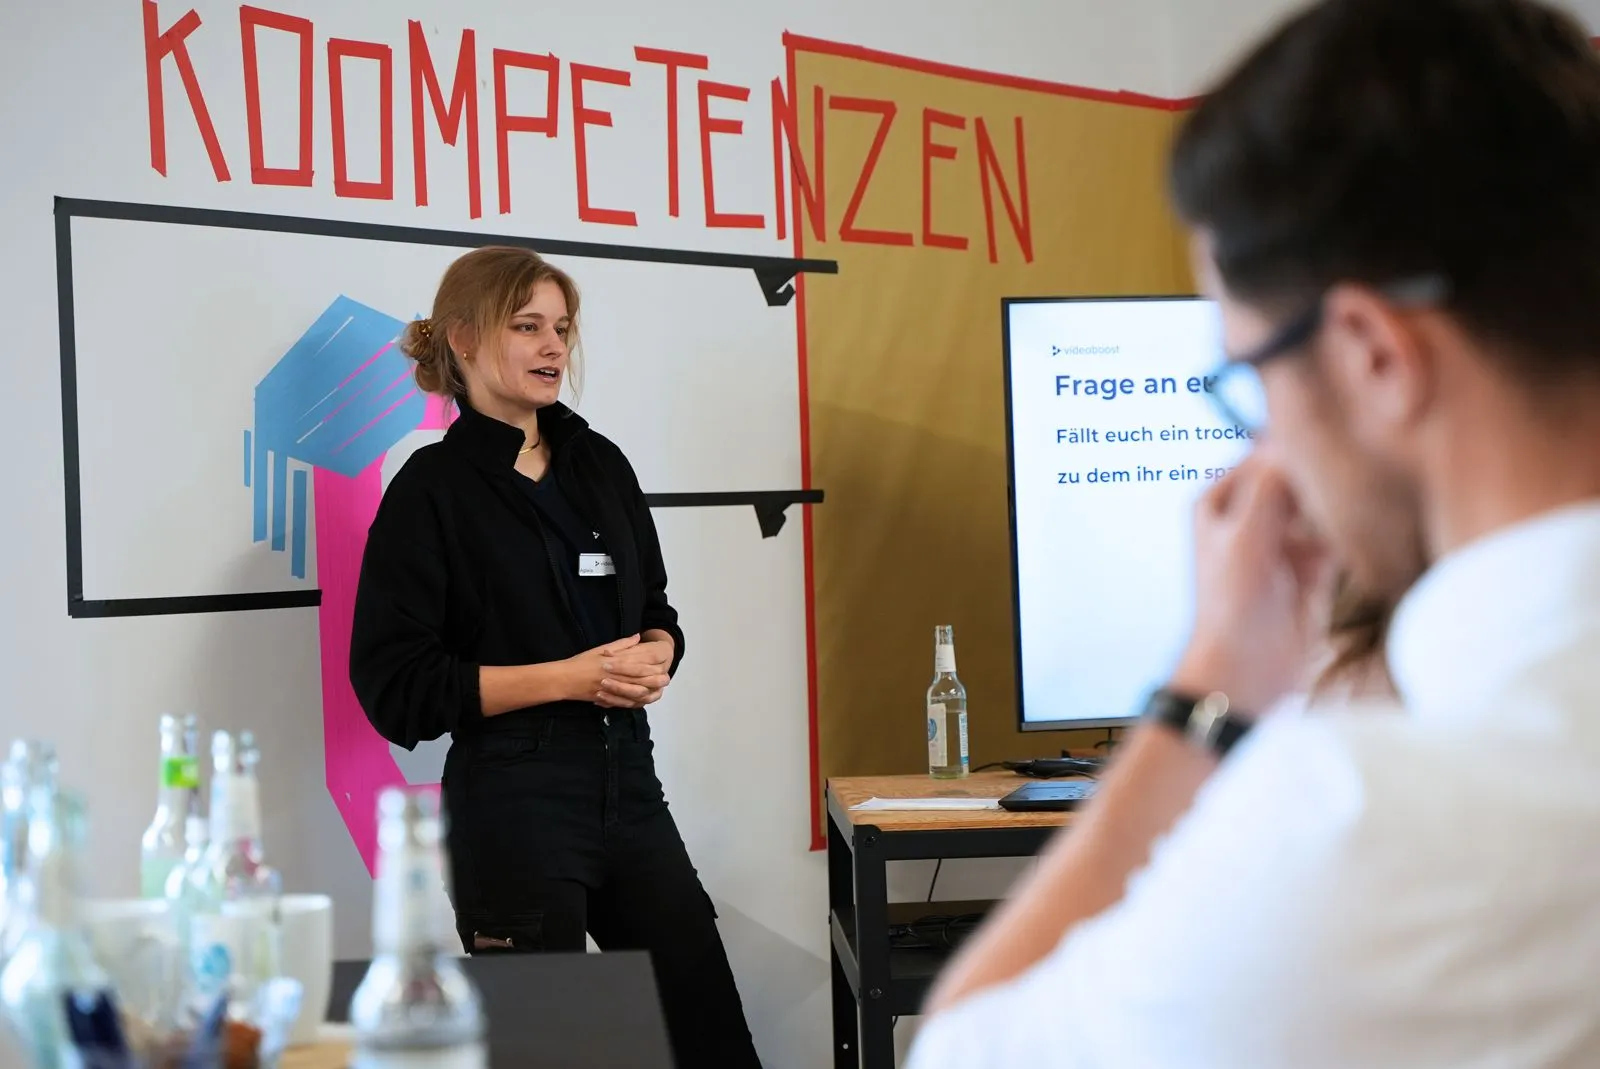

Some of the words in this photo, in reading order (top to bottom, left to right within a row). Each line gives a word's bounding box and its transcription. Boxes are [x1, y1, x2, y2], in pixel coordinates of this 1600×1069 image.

[1064, 344, 1120, 355] videoboost
[1055, 374, 1135, 400] Frage
[1143, 376, 1177, 394] an
[1056, 427, 1099, 444] Fällt
[1105, 426, 1153, 442] euch
[1160, 425, 1189, 441] ein
[1058, 471, 1080, 484] zu
[1086, 468, 1131, 483] dem
[1137, 466, 1163, 481] ihr
[1169, 464, 1198, 480] ein
